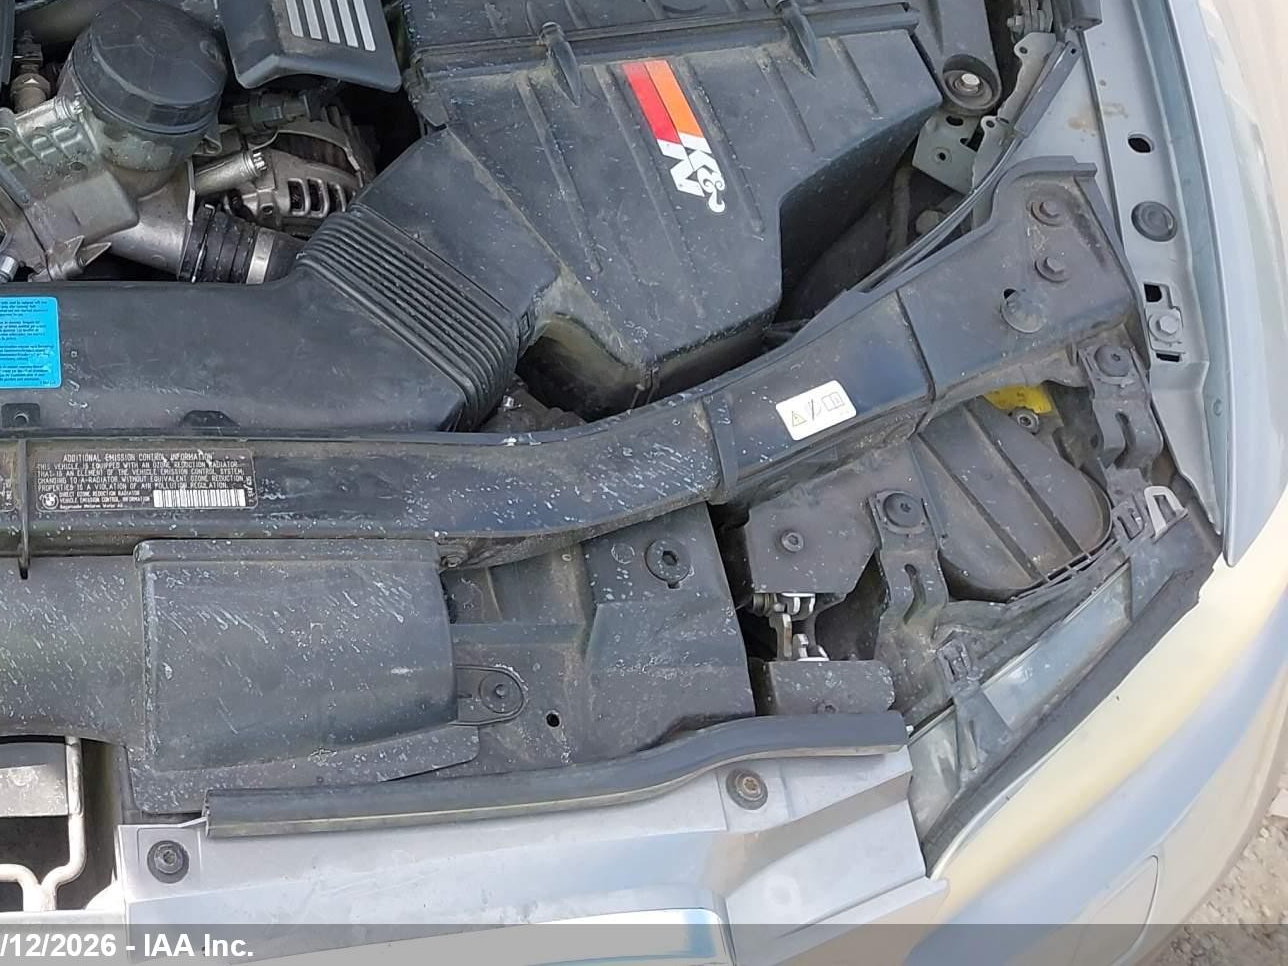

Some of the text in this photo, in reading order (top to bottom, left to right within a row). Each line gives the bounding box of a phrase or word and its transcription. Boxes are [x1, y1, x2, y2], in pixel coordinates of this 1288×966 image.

[63, 451, 213, 463] ADDITIONAL EMISSION CONTROL INFORMATION
[37, 463, 51, 471] THIS
[54, 462, 79, 470] VEHICLE
[82, 462, 89, 470] IS
[91, 461, 121, 470] EQUIPPED
[123, 461, 139, 469] WITH
[152, 460, 171, 468] OZONE
[173, 460, 206, 468] REDUCTION
[65, 469, 75, 477] AN
[77, 468, 103, 477] ELEMENT
[106, 468, 115, 476] OF
[118, 468, 129, 476] THE
[132, 467, 157, 476] VEHICLE
[160, 467, 188, 476] EMISSION
[190, 467, 216, 476] CONTROL
[37, 476, 67, 485] CHANGING
[70, 476, 78, 484] TO
[88, 475, 118, 483] RADIATOR
[121, 475, 148, 483] WITHOUT
[150, 474, 188, 483] EQUIVALENT
[190, 474, 209, 482] OZONE
[211, 474, 243, 482] REDUCTION
[37, 483, 74, 492] PROPERTIES
[76, 483, 83, 491] IS
[86, 483, 91, 491] A
[94, 482, 127, 491] VIOLATION
[129, 482, 137, 490] OF
[140, 482, 151, 490] AIR
[154, 481, 187, 490] POLLUTION
